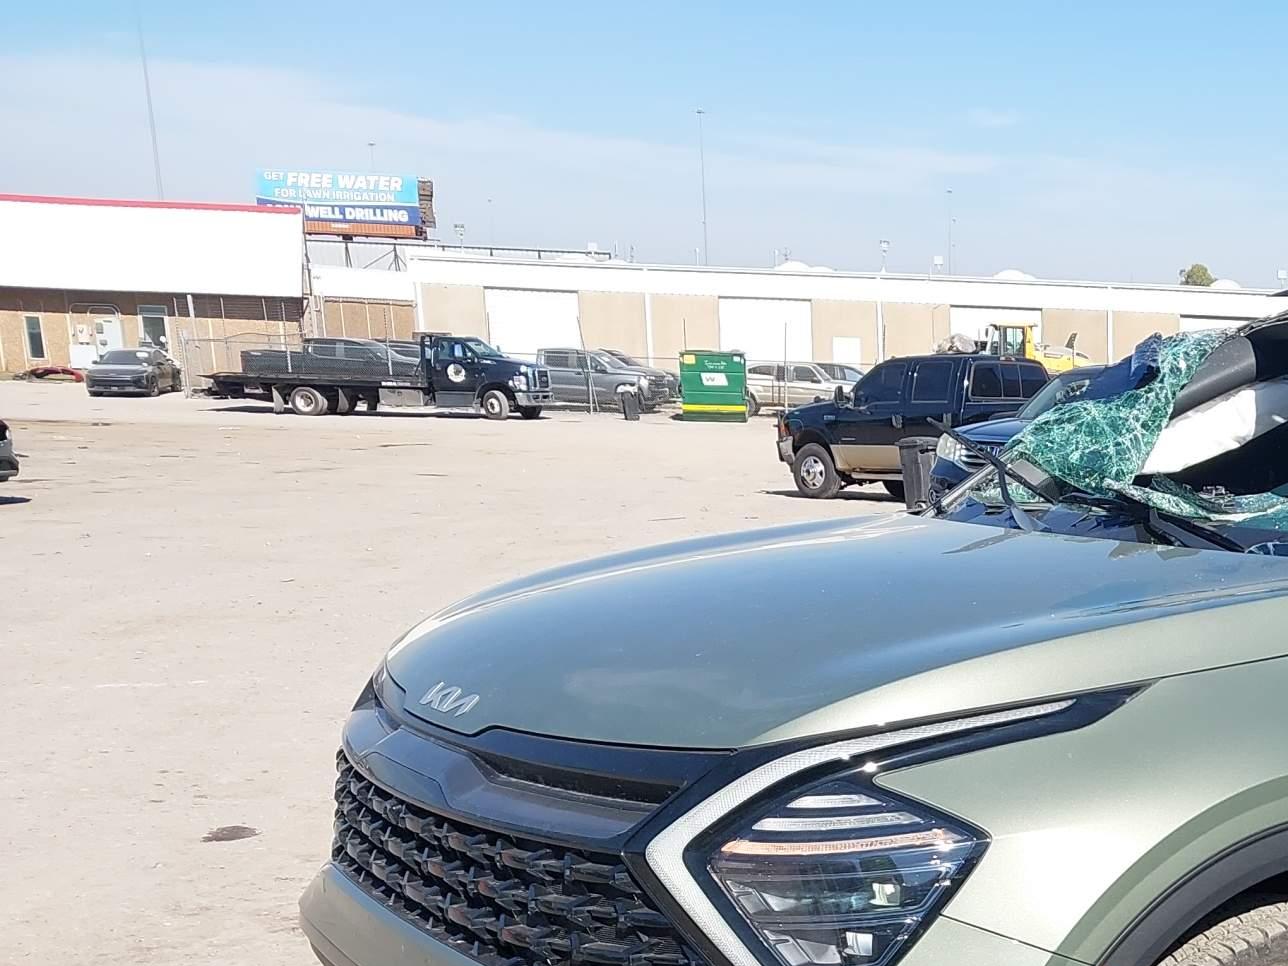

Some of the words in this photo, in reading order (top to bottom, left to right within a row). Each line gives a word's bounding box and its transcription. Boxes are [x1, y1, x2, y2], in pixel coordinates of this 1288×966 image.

[264, 172, 283, 180] GET
[287, 172, 333, 187] FREE
[337, 175, 403, 191] WATER
[275, 188, 297, 198] FOR
[298, 189, 331, 200] LAWN
[333, 191, 394, 202] IRRIGATION
[304, 206, 344, 219] WELL
[346, 208, 408, 222] DRILLING
